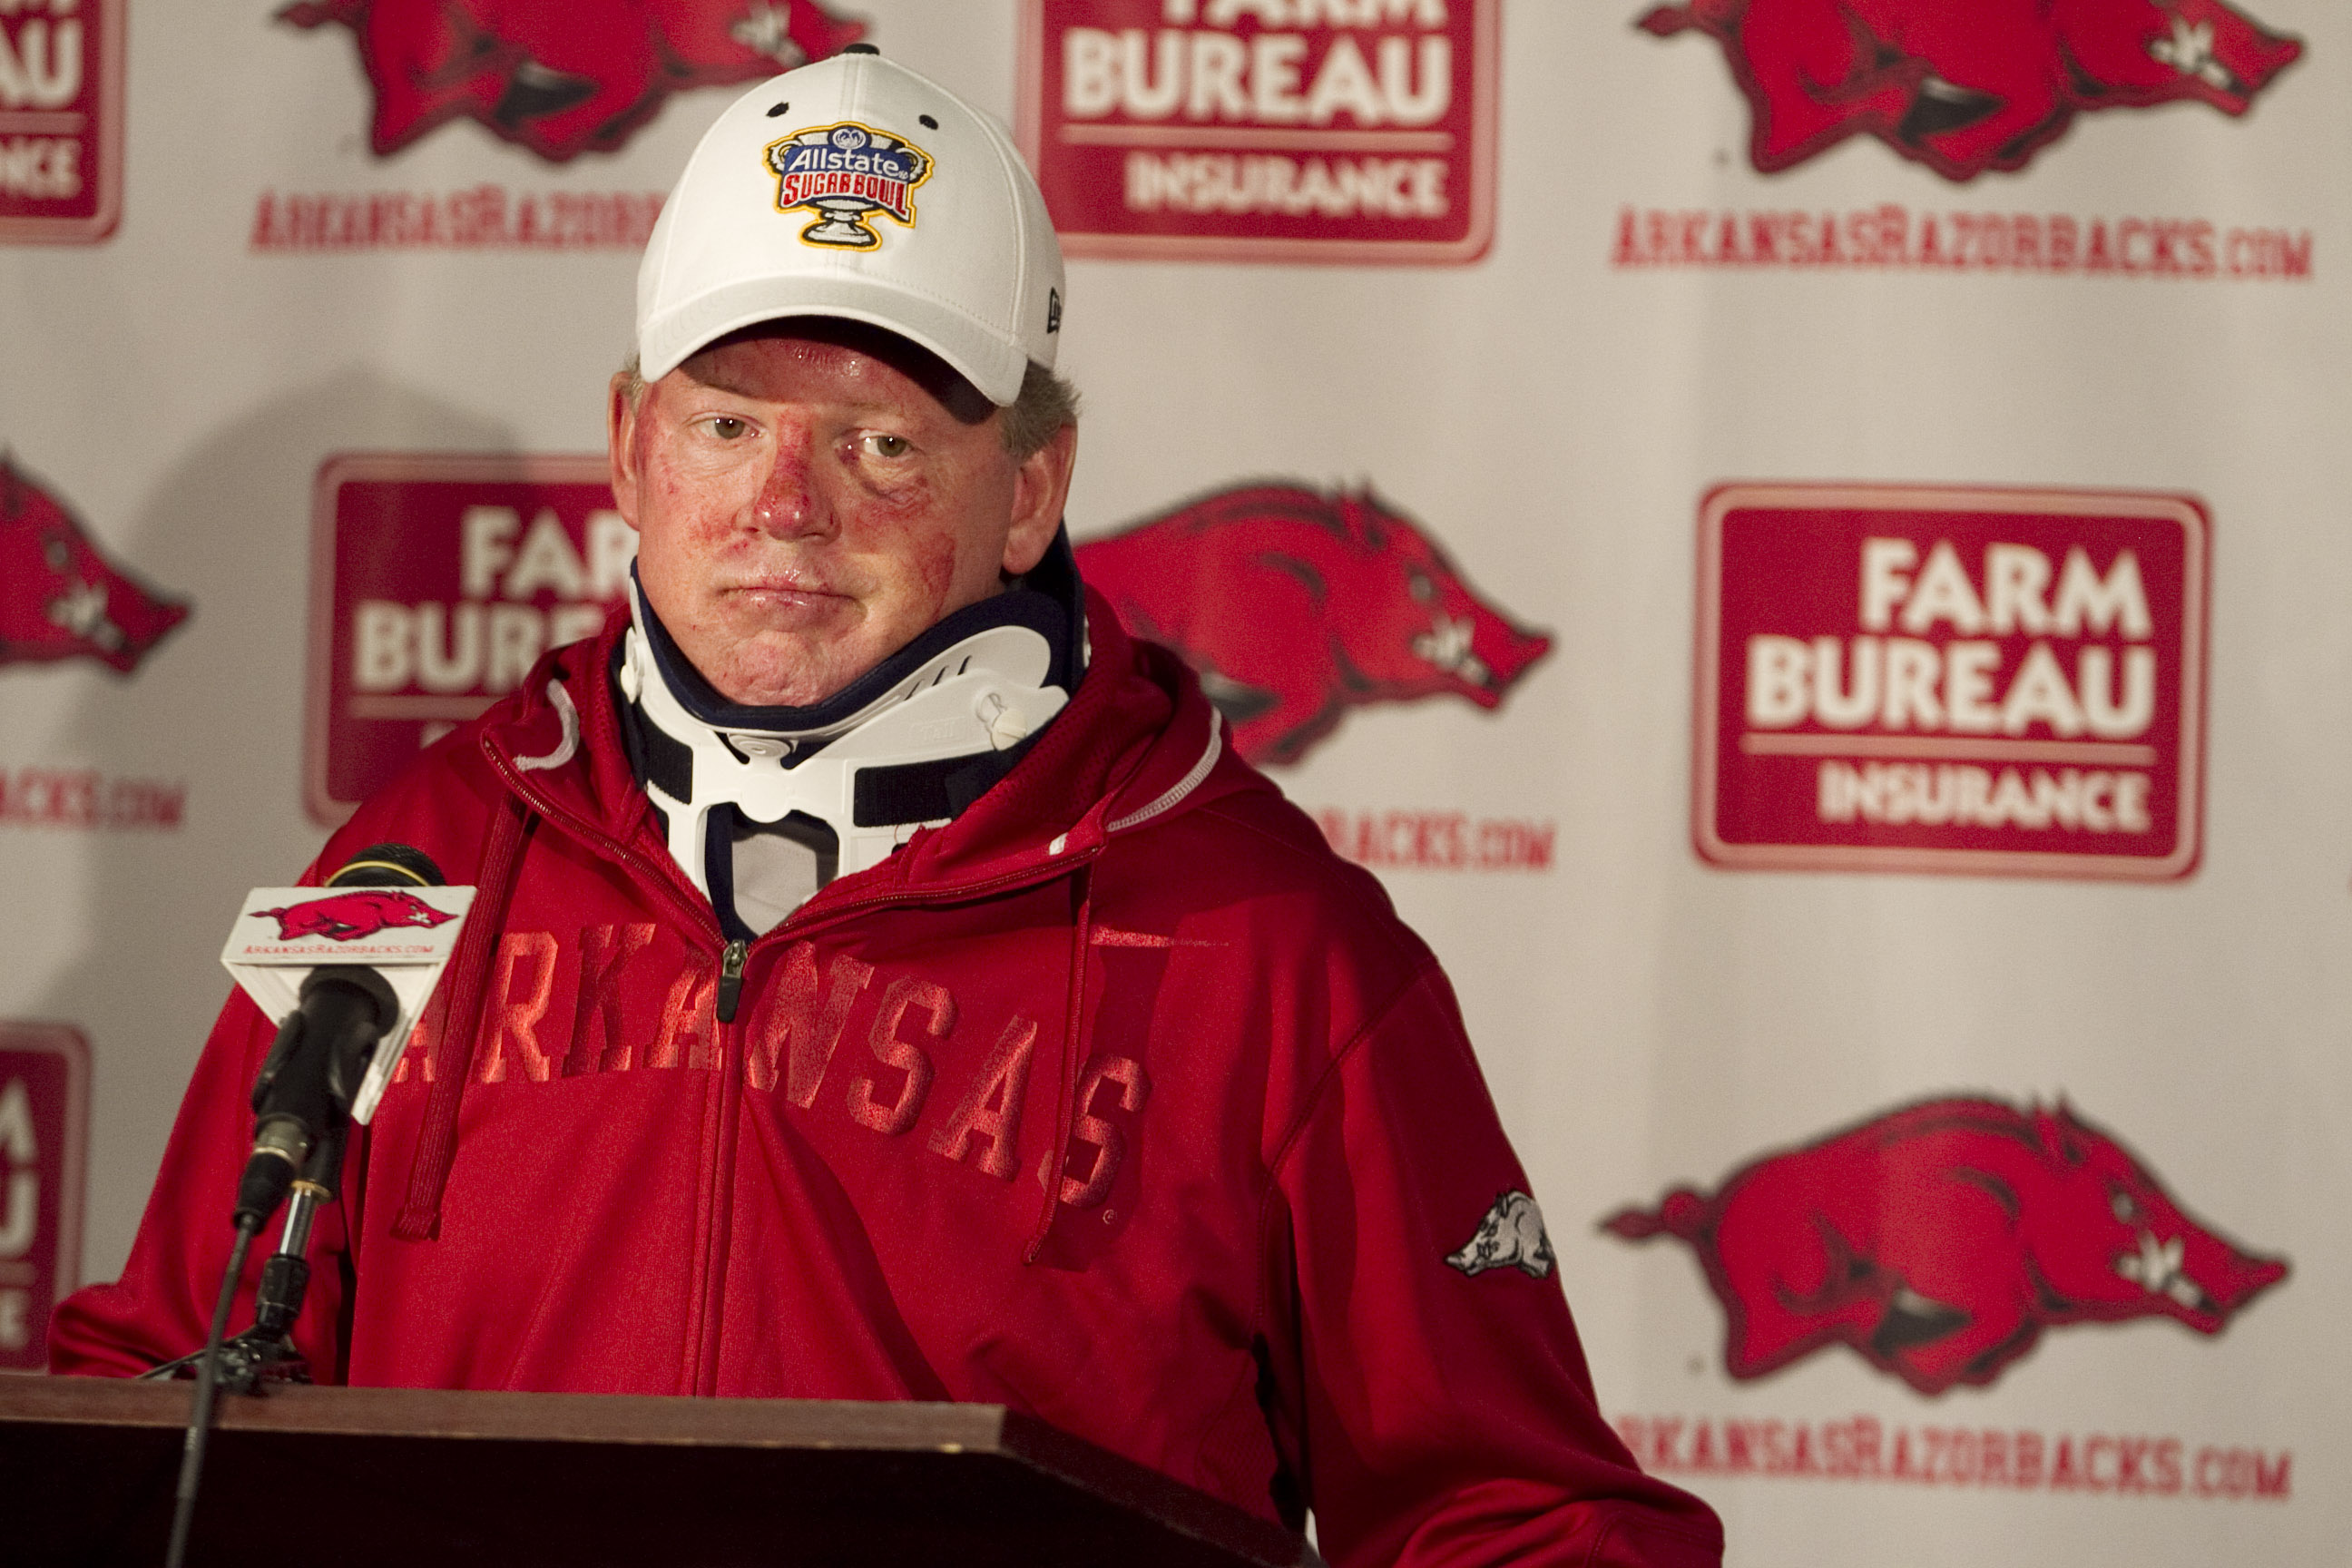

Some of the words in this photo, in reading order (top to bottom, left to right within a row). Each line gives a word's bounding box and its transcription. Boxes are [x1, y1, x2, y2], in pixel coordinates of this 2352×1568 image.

[1062, 27, 1452, 127] BUREAU
[782, 172, 851, 206] SUGAR
[852, 173, 907, 216] BOWL
[788, 148, 899, 177] Allstate
[1123, 151, 1451, 218] INSURANCE
[1611, 203, 2313, 281] ARKANSASRAZORBACKS.COM
[461, 503, 640, 599] FAR
[1858, 535, 2151, 637] FARM
[1746, 633, 2157, 740] BUREAU
[1818, 759, 2151, 833] INSURANCE
[1617, 1416, 2292, 1502] RKANSASRAZORBACKS.COM
